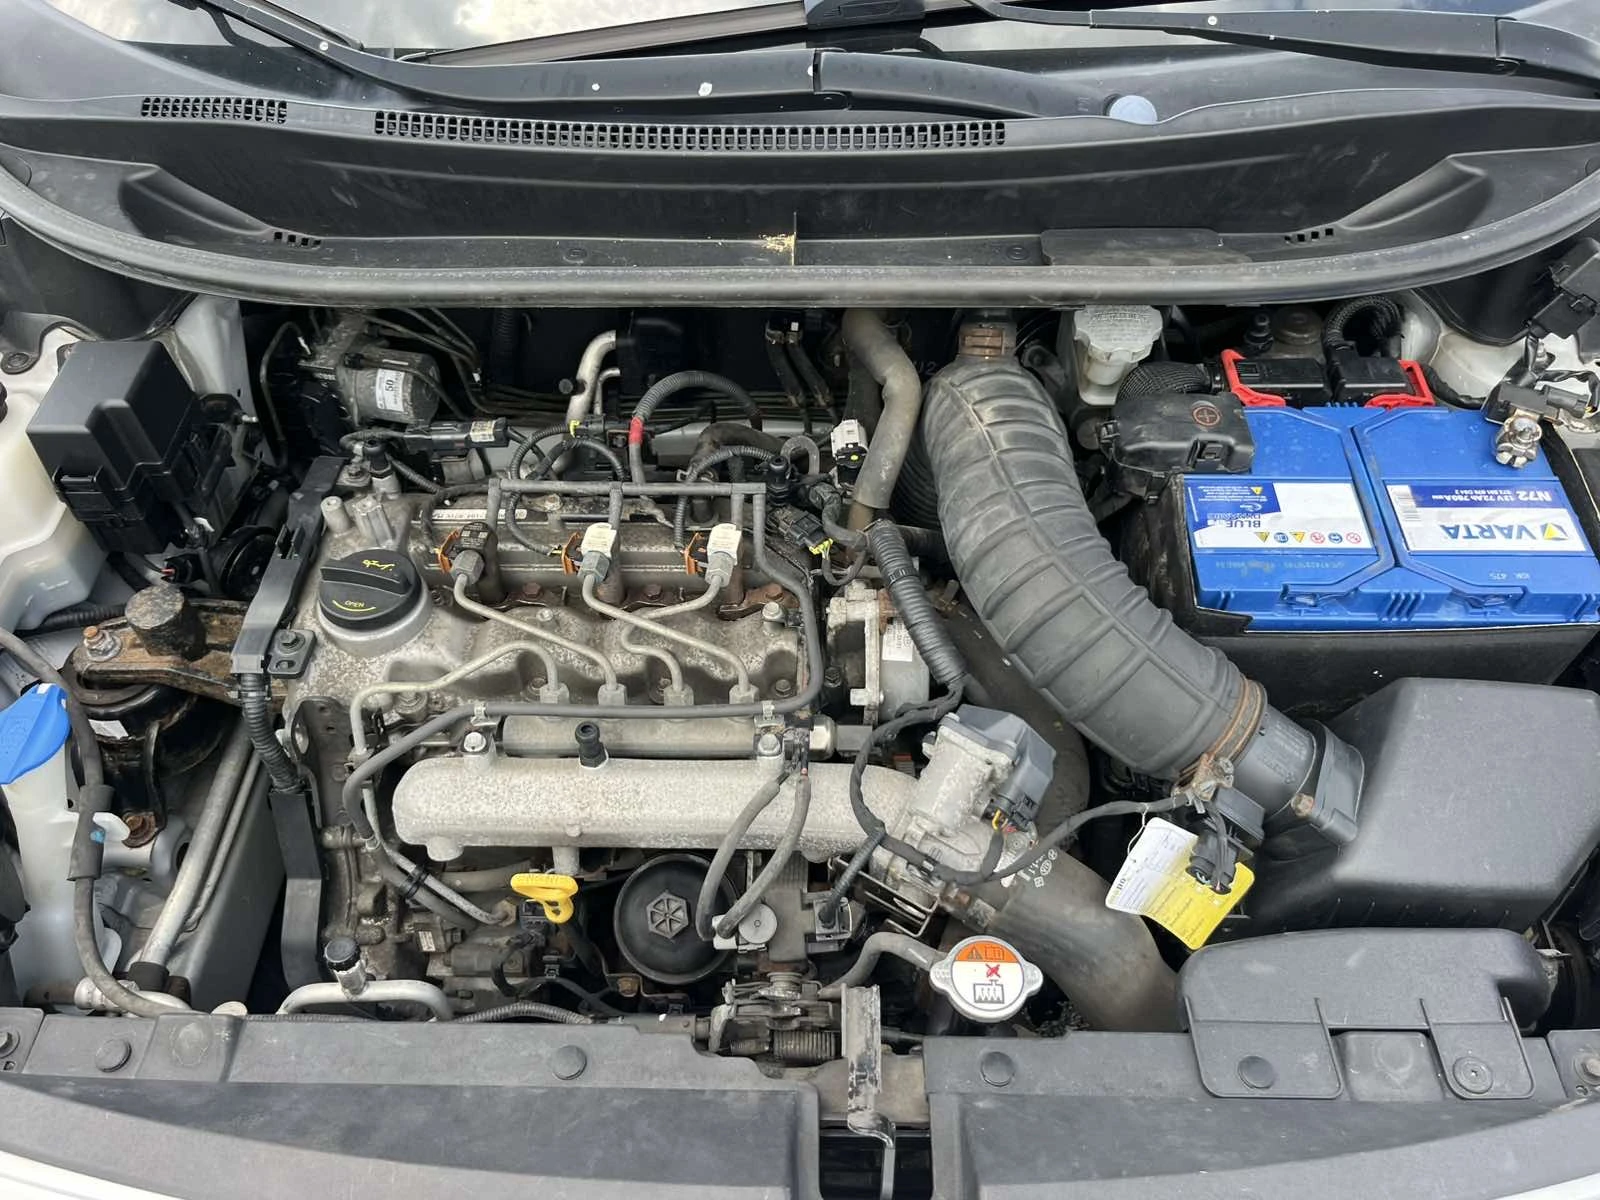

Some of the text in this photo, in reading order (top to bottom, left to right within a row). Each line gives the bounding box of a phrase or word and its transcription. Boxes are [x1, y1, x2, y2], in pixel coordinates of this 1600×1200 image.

[384, 379, 394, 391] 50
[1516, 490, 1552, 502] N72
[1226, 520, 1261, 528] BLUE
[1440, 524, 1537, 540] VARTA
[344, 600, 365, 608] OPEN
